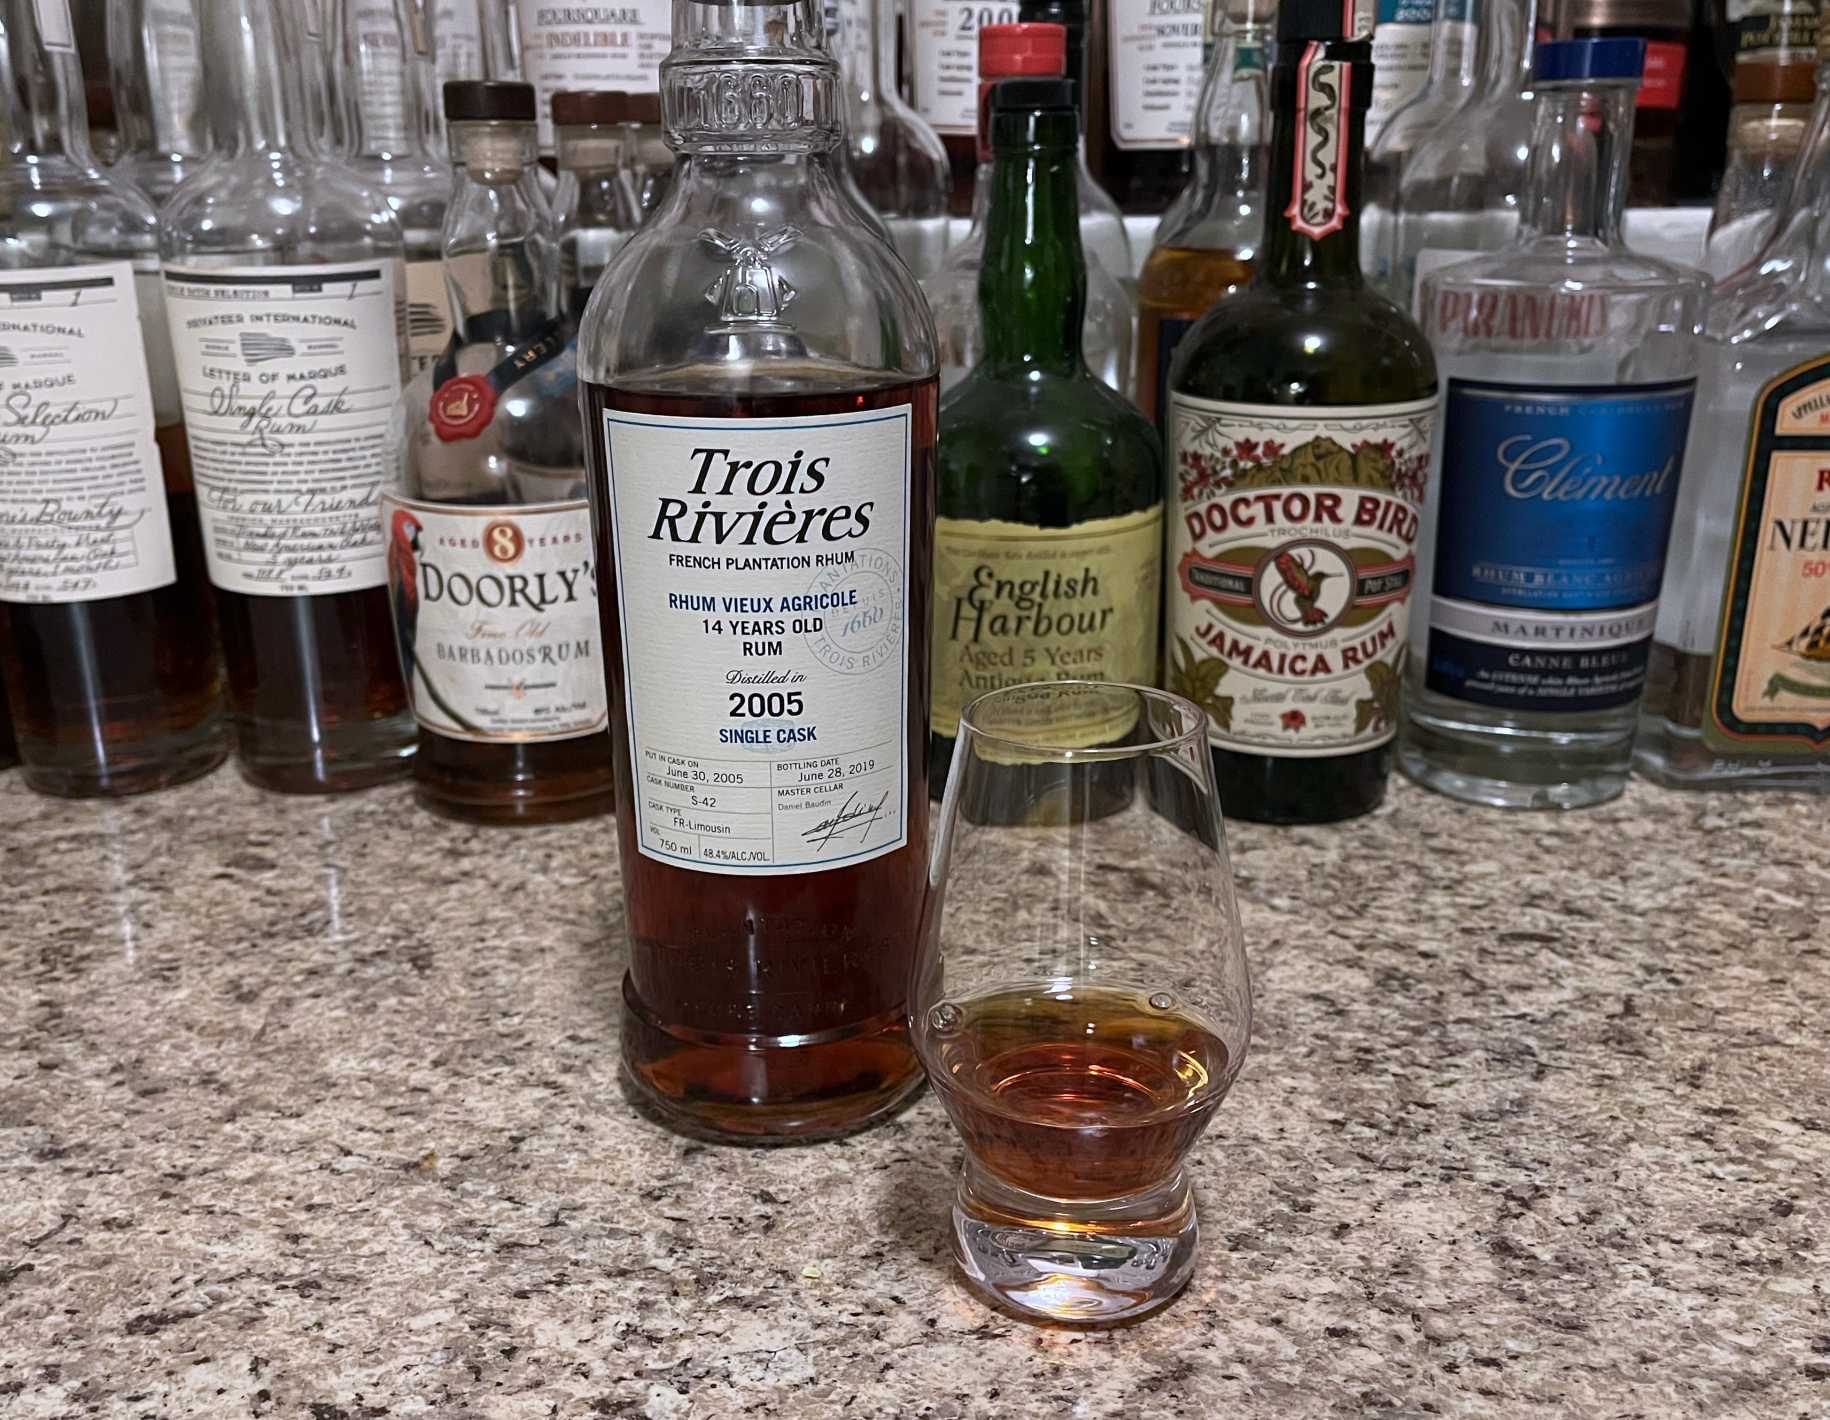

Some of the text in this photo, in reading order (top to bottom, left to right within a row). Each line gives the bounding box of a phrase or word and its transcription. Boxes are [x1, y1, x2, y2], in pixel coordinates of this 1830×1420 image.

[249, 312, 358, 330] INTERNATIONAL
[12, 373, 76, 391] MARQUE
[202, 365, 348, 384] LETTER OF MARQUE
[4, 391, 119, 430] Selection
[287, 385, 352, 418] Cask
[1505, 404, 1571, 417] FRENCH
[0, 427, 50, 445] um
[688, 447, 831, 496] Trois
[1497, 434, 1675, 501] Clément
[647, 497, 875, 546] Rivières
[1185, 492, 1420, 545] DOCTOR BIRD
[439, 525, 583, 560] AGED 8 YEARS
[1268, 527, 1351, 539] TROCHILUS
[669, 551, 855, 570] FRENCH PLANTATION RHUM
[967, 564, 1100, 612] English
[669, 589, 858, 613] RHUM VIEUX AGRICOLE
[702, 617, 824, 636] 14 YEARS OLD
[841, 605, 885, 638] 1660
[950, 596, 1115, 643] Harbour
[436, 639, 593, 667] BARBADOS RUM
[742, 640, 783, 657] RUM
[1195, 619, 1397, 677] JAMAICA RUM
[1264, 637, 1339, 650] POLYTMUS
[814, 636, 857, 671] TROIS
[959, 644, 1105, 671] Aged 5 Years
[1508, 652, 1572, 670] CANNE
[725, 669, 808, 686] Distilled in
[959, 670, 1046, 690] Antig
[729, 691, 805, 718] 2005
[719, 725, 818, 745] SINGLE CASK
[645, 750, 699, 769] PUT IN CASK ON
[776, 757, 840, 772] BOTTLING DATE
[666, 766, 744, 785] June 30, 2005
[798, 759, 875, 783] June 28, 2019
[646, 775, 695, 793] CASK NUMBER
[777, 782, 844, 798] MASTER CELLAR
[648, 801, 683, 817] CASK TYPE
[691, 795, 717, 808] S-42
[778, 802, 803, 811] Daniel
[673, 817, 731, 835] FR-Limousin
[660, 838, 692, 855] 750 ml
